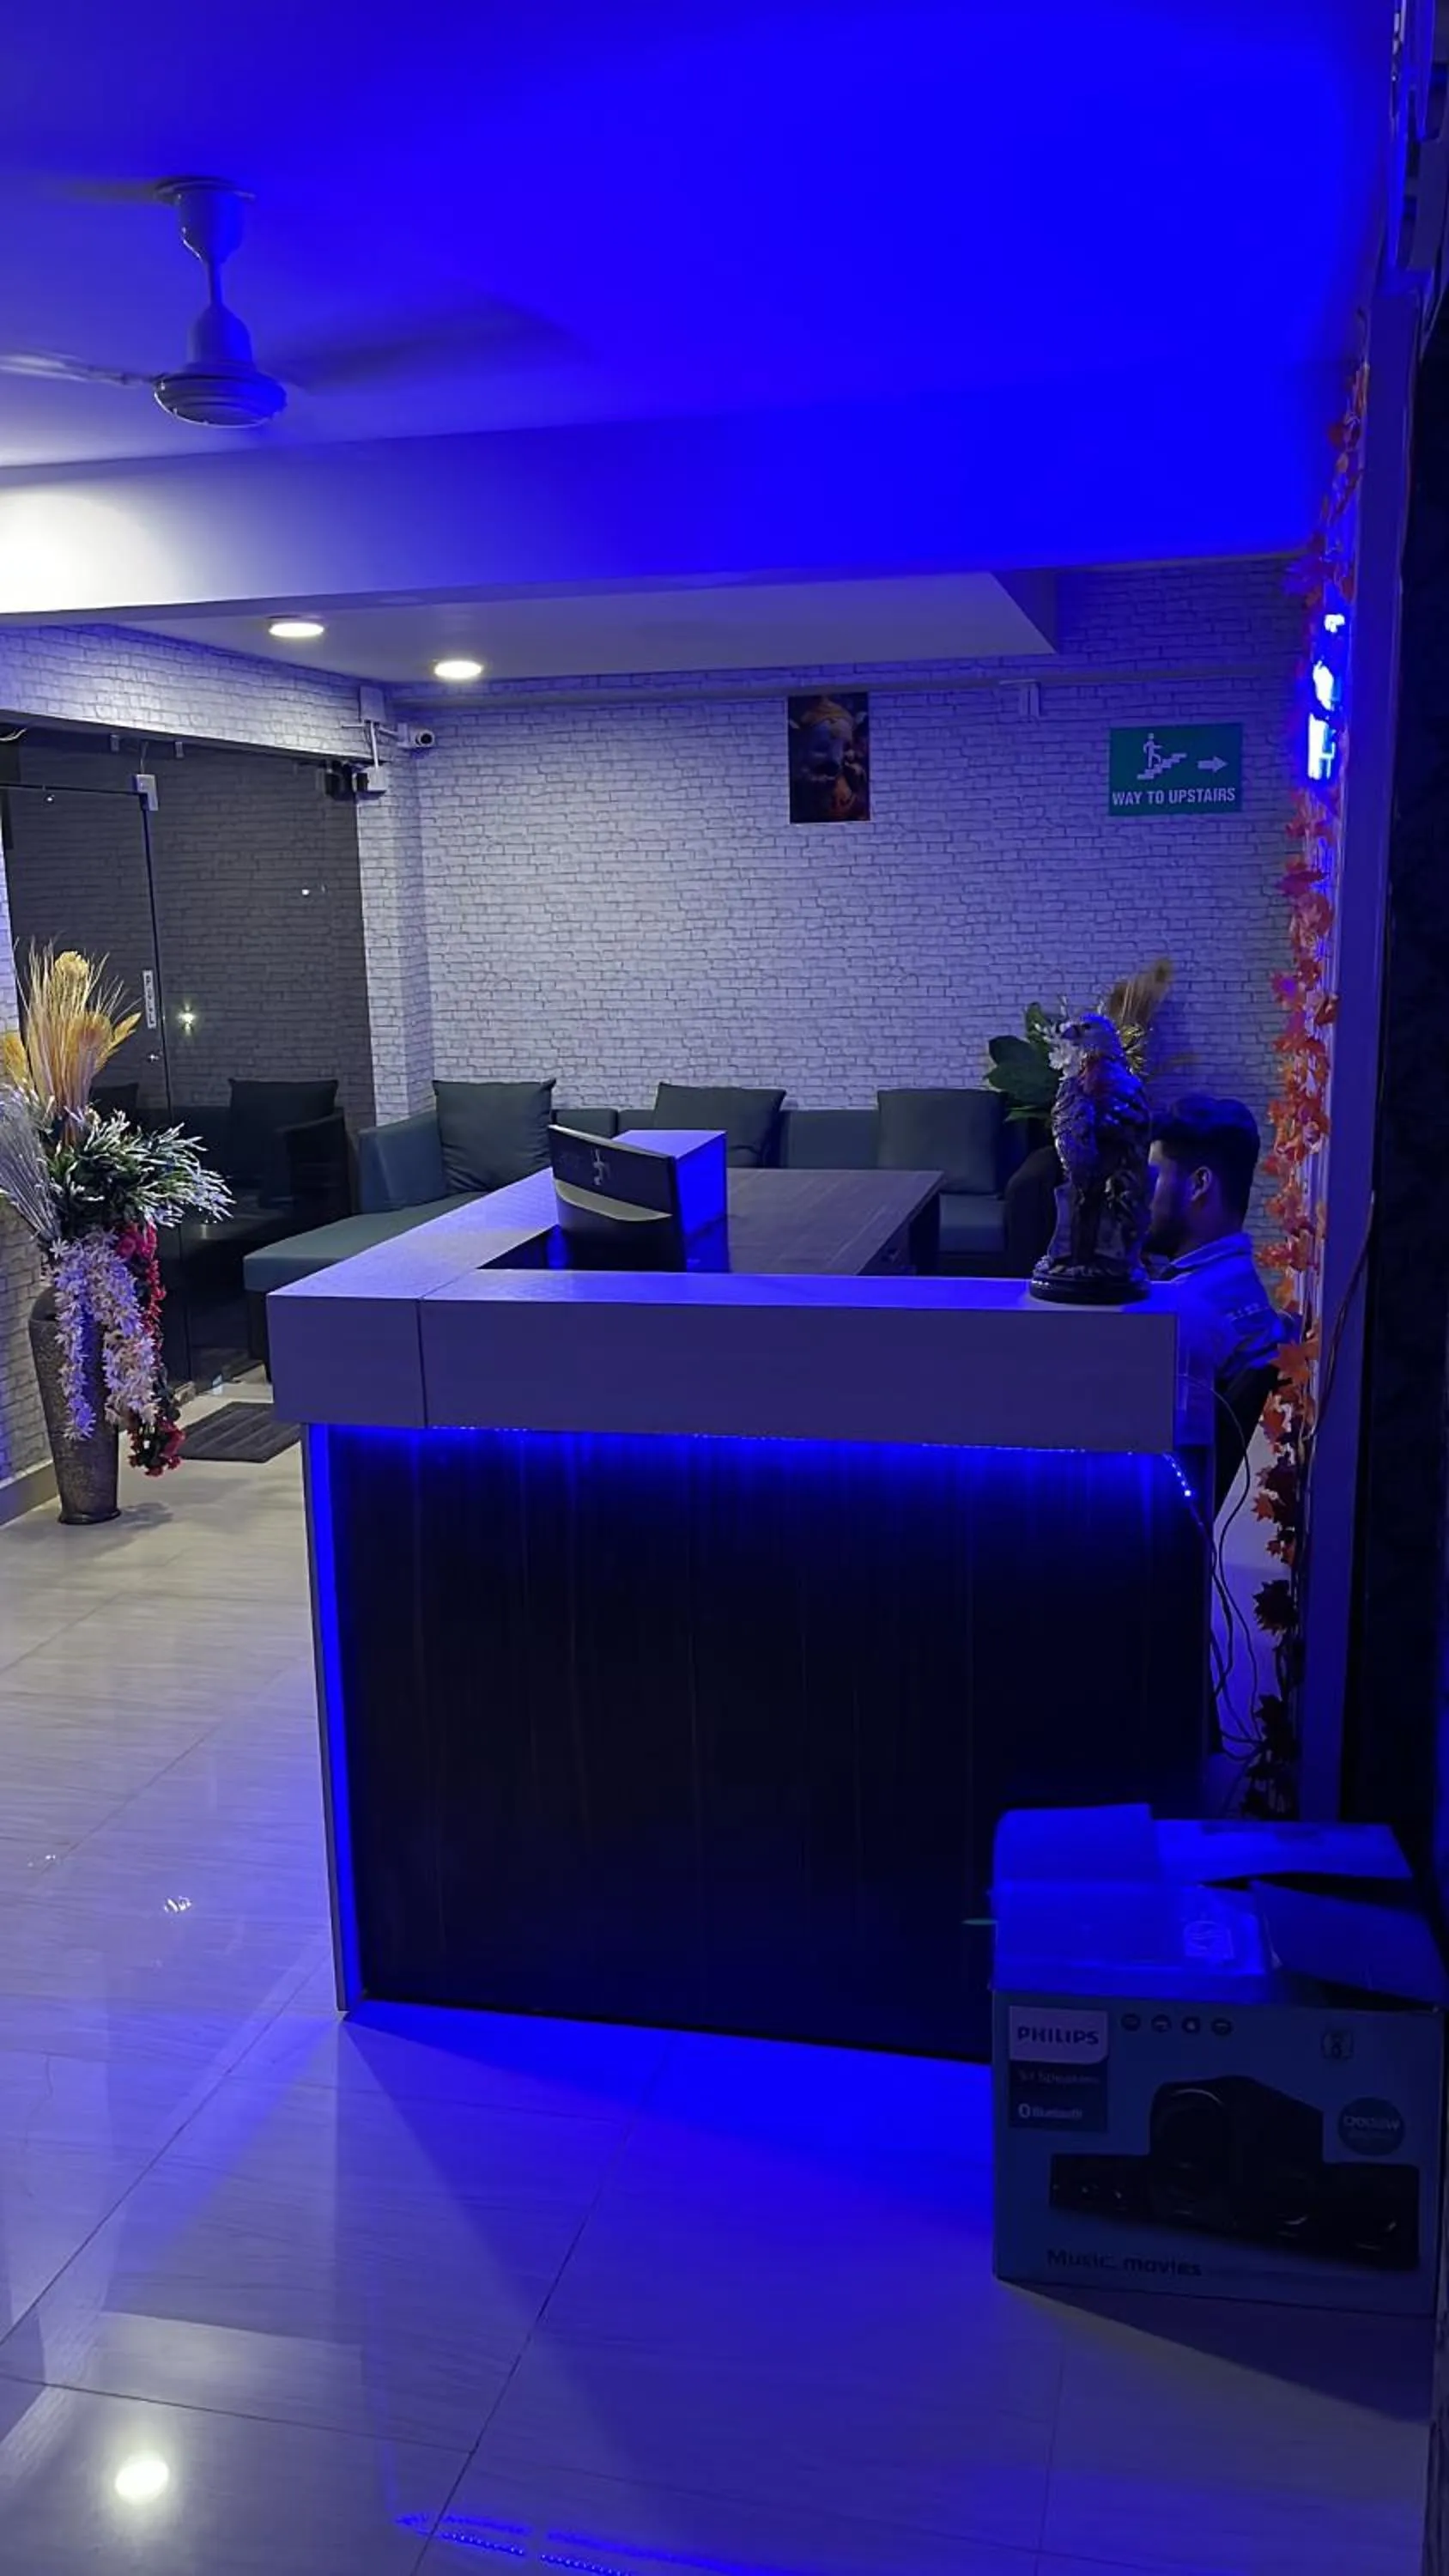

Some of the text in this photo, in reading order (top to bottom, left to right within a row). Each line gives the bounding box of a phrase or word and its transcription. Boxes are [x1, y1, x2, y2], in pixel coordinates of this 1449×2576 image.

[1112, 787, 1236, 805] WAY TO UPSTAIRS
[1018, 2026, 1099, 2044] PHILIPS
